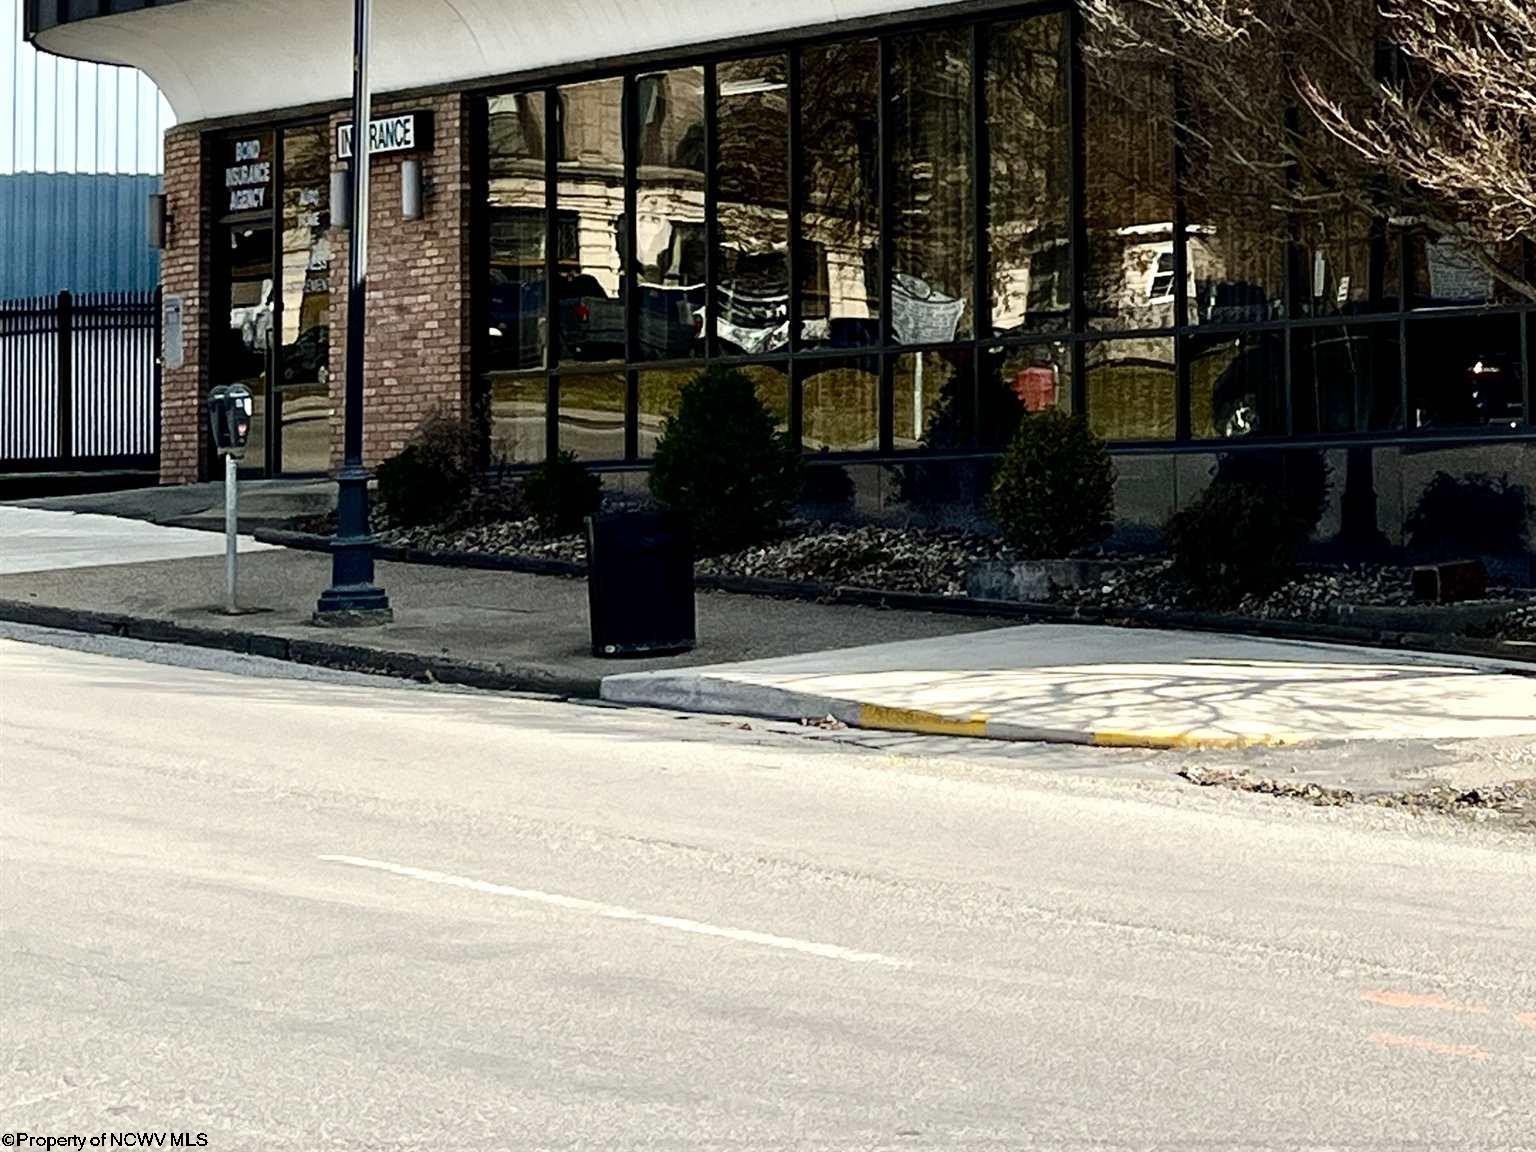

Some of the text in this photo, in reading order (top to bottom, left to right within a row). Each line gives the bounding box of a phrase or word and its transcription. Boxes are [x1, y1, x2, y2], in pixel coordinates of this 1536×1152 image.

[341, 118, 412, 156] INRANCE
[235, 139, 261, 162] BOND
[225, 161, 271, 187] INSURANCE
[229, 187, 266, 211] AGENCY
